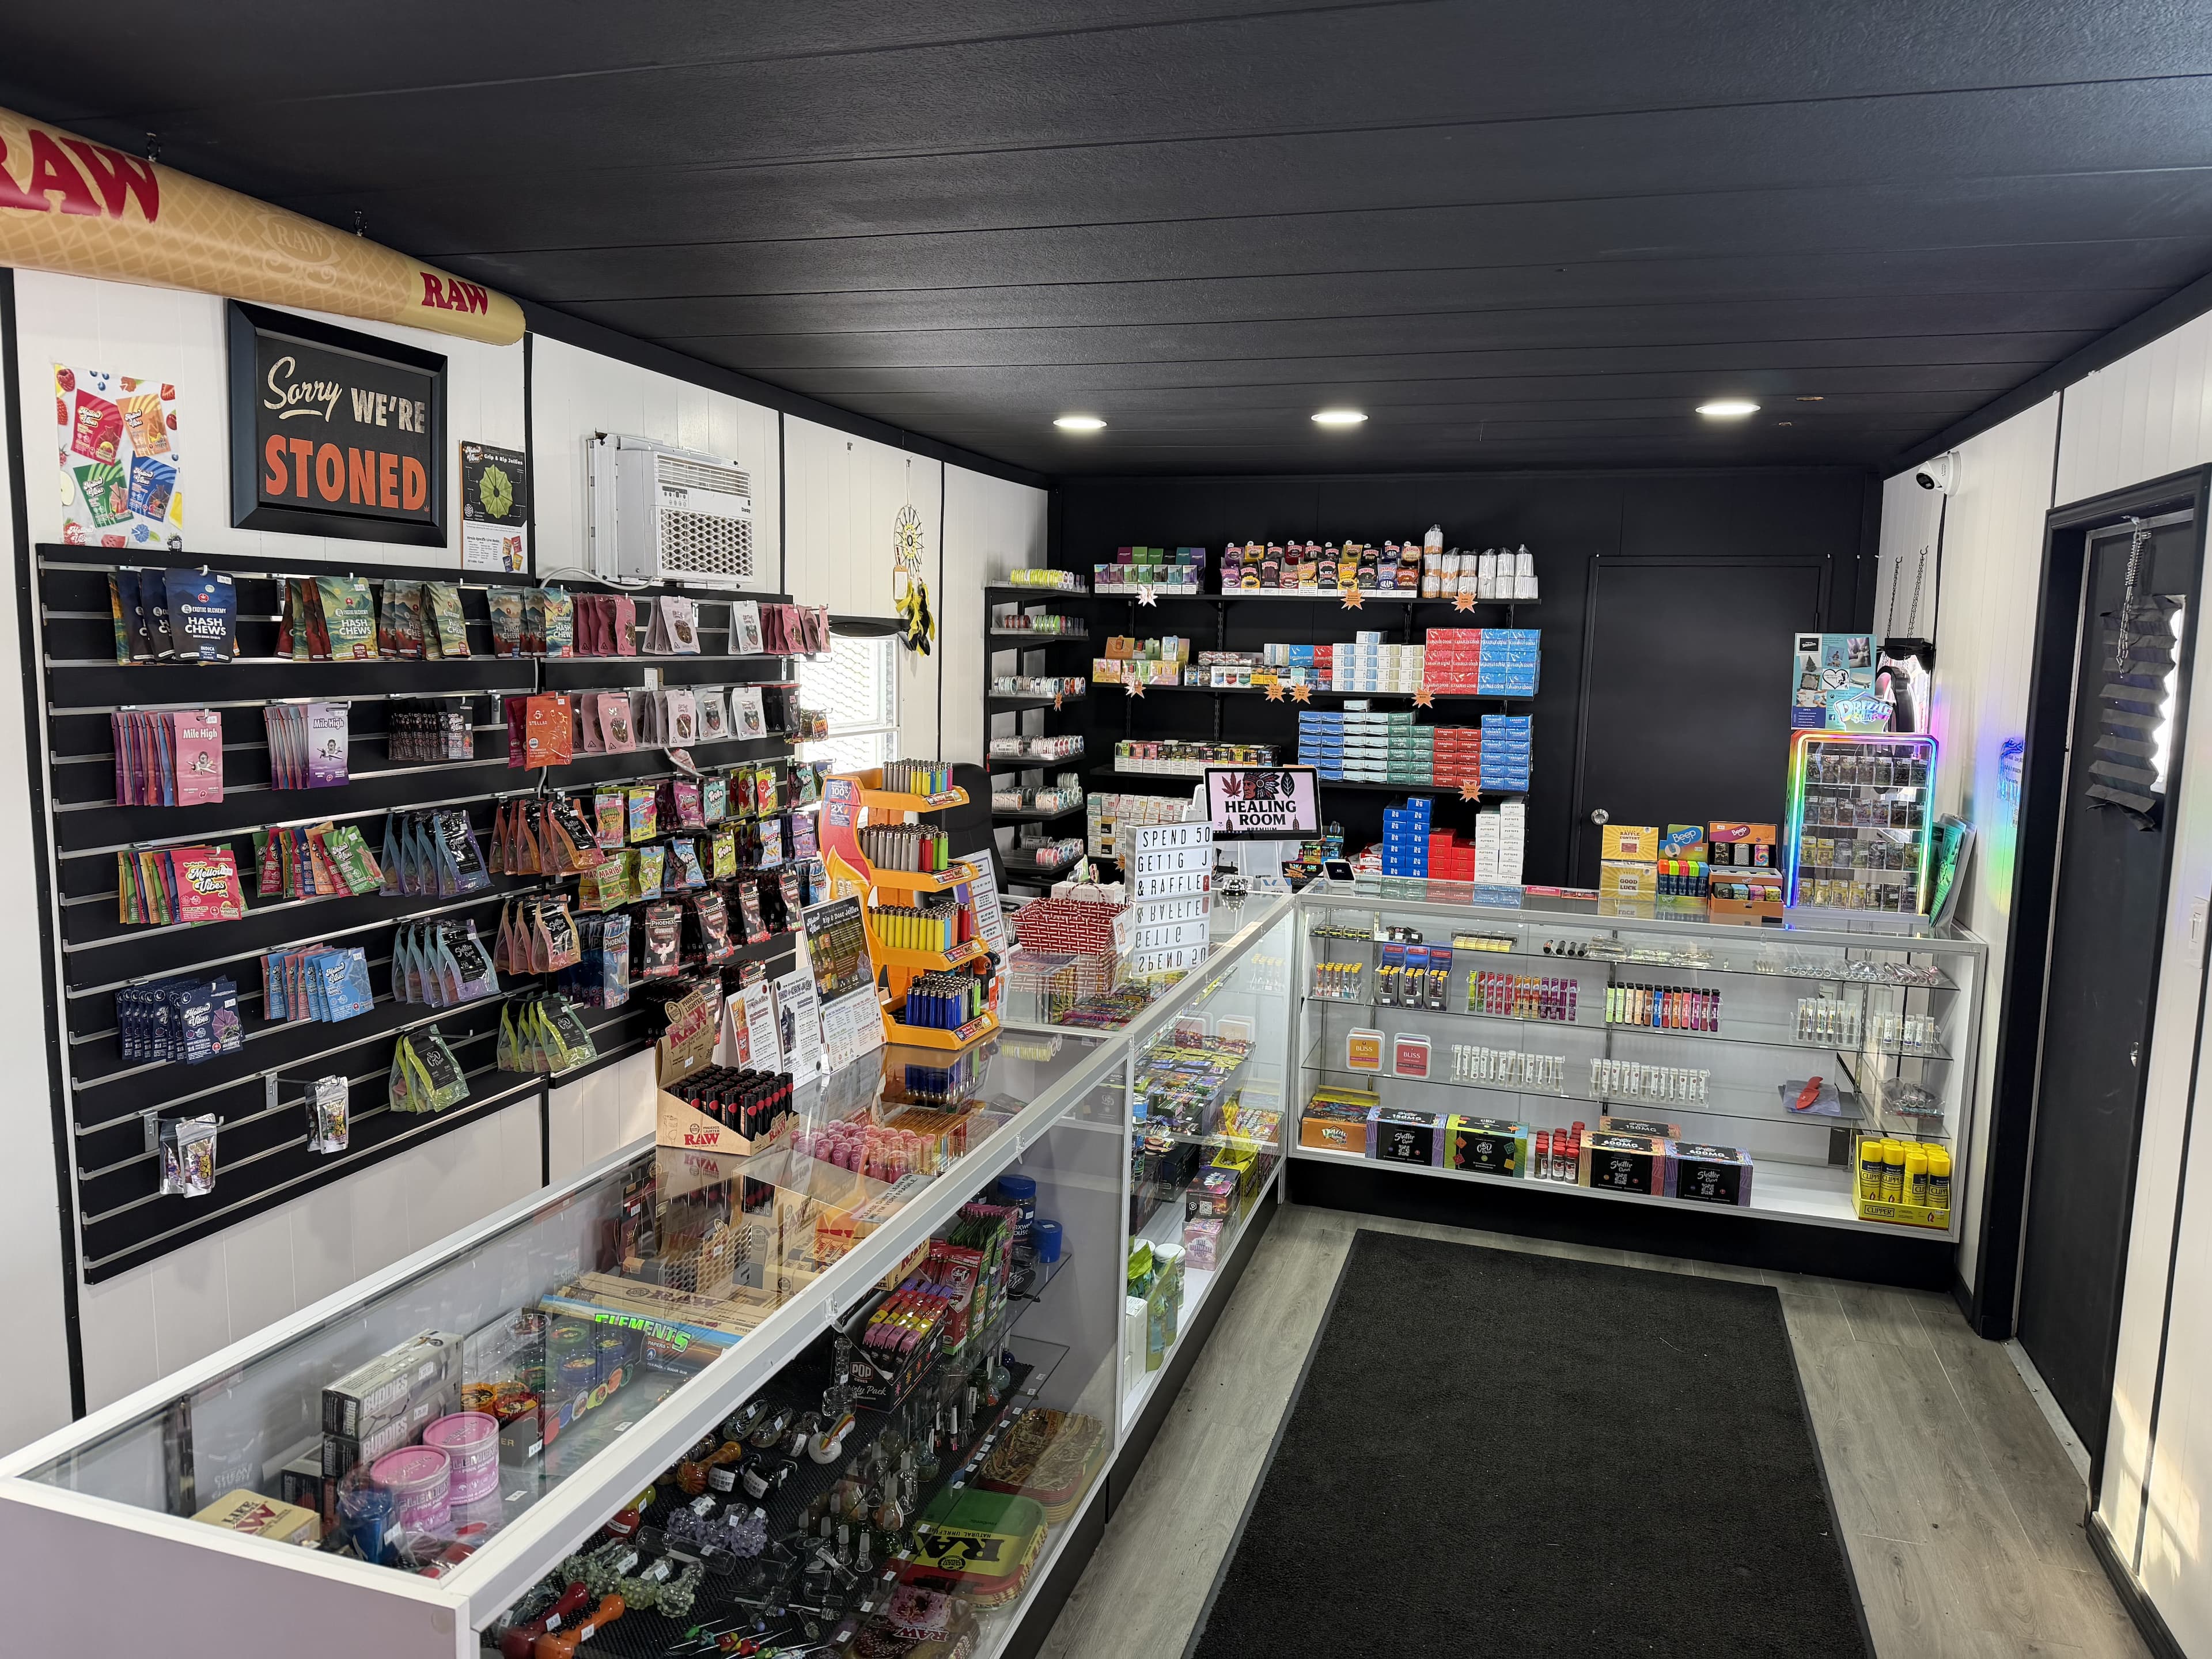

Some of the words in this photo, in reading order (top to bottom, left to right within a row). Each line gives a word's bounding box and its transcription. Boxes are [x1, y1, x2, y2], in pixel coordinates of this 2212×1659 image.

[420, 272, 488, 316] RAW
[264, 356, 344, 422] Sorry
[351, 387, 426, 434] WE'RE
[264, 434, 427, 511] STONED
[188, 616, 222, 627] HASH
[342, 619, 368, 627] HASH
[185, 624, 226, 635] CHEWS
[339, 626, 371, 635] CHEWS
[313, 719, 328, 729] Mile
[328, 718, 344, 729] High
[183, 729, 199, 738] Mile
[200, 729, 217, 740] High
[832, 787, 849, 796] 100%
[831, 805, 843, 813] 2X
[1225, 800, 1296, 813] HEALING
[1240, 814, 1286, 825] ROOM
[1143, 829, 1186, 847] SPEND
[1196, 826, 1210, 843] 50
[1672, 830, 1696, 843] Beep
[1732, 827, 1747, 836] Beep
[1202, 850, 1207, 866] J
[188, 864, 228, 881] Mellow
[195, 878, 225, 892] Vibes
[1138, 880, 1144, 896] &
[1151, 874, 1201, 894] RAFFLE
[703, 906, 723, 915] PHOENIX
[845, 906, 859, 916] Jellies
[605, 934, 626, 949] PHOENIX
[326, 962, 344, 976] Mellow
[744, 974, 763, 984] PHOENIX
[681, 991, 700, 1005] PHOENIX
[184, 1002, 211, 1019] Mellow
[685, 999, 704, 1013] LIGHTER
[189, 1015, 209, 1026] Vibes
[670, 1003, 707, 1048] RAW
[770, 1119, 786, 1142] RAW
[1626, 1124, 1657, 1132] 150MG
[684, 1134, 719, 1145] RAW
[1604, 1140, 1638, 1148] 600MG
[1690, 1150, 1725, 1158] 600MG
[1611, 1160, 1633, 1169] Shatter
[1697, 1171, 1720, 1180] Shatter
[891, 1181, 903, 1193] LEAN
[885, 1195, 897, 1207] VERY
[1867, 1206, 1892, 1215] CLIPPER
[815, 1240, 825, 1254] RAW
[825, 1246, 837, 1258] RAW
[1188, 1244, 1214, 1255] ULTIMATE
[894, 1274, 899, 1282] 6
[594, 1313, 691, 1353] ELEMENTS
[647, 1340, 666, 1350] PAPERS
[852, 1364, 872, 1377] POP
[363, 1373, 408, 1412] BUDDIES
[866, 1385, 887, 1395] Pack
[345, 1400, 357, 1435] BUDDIES
[362, 1416, 408, 1459] BUDDIES
[324, 1441, 336, 1476] BUDDIES
[462, 1465, 476, 1474] PINK
[222, 1501, 253, 1522] LIKE
[417, 1502, 431, 1511] PINK
[895, 1628, 949, 1642] RAW
